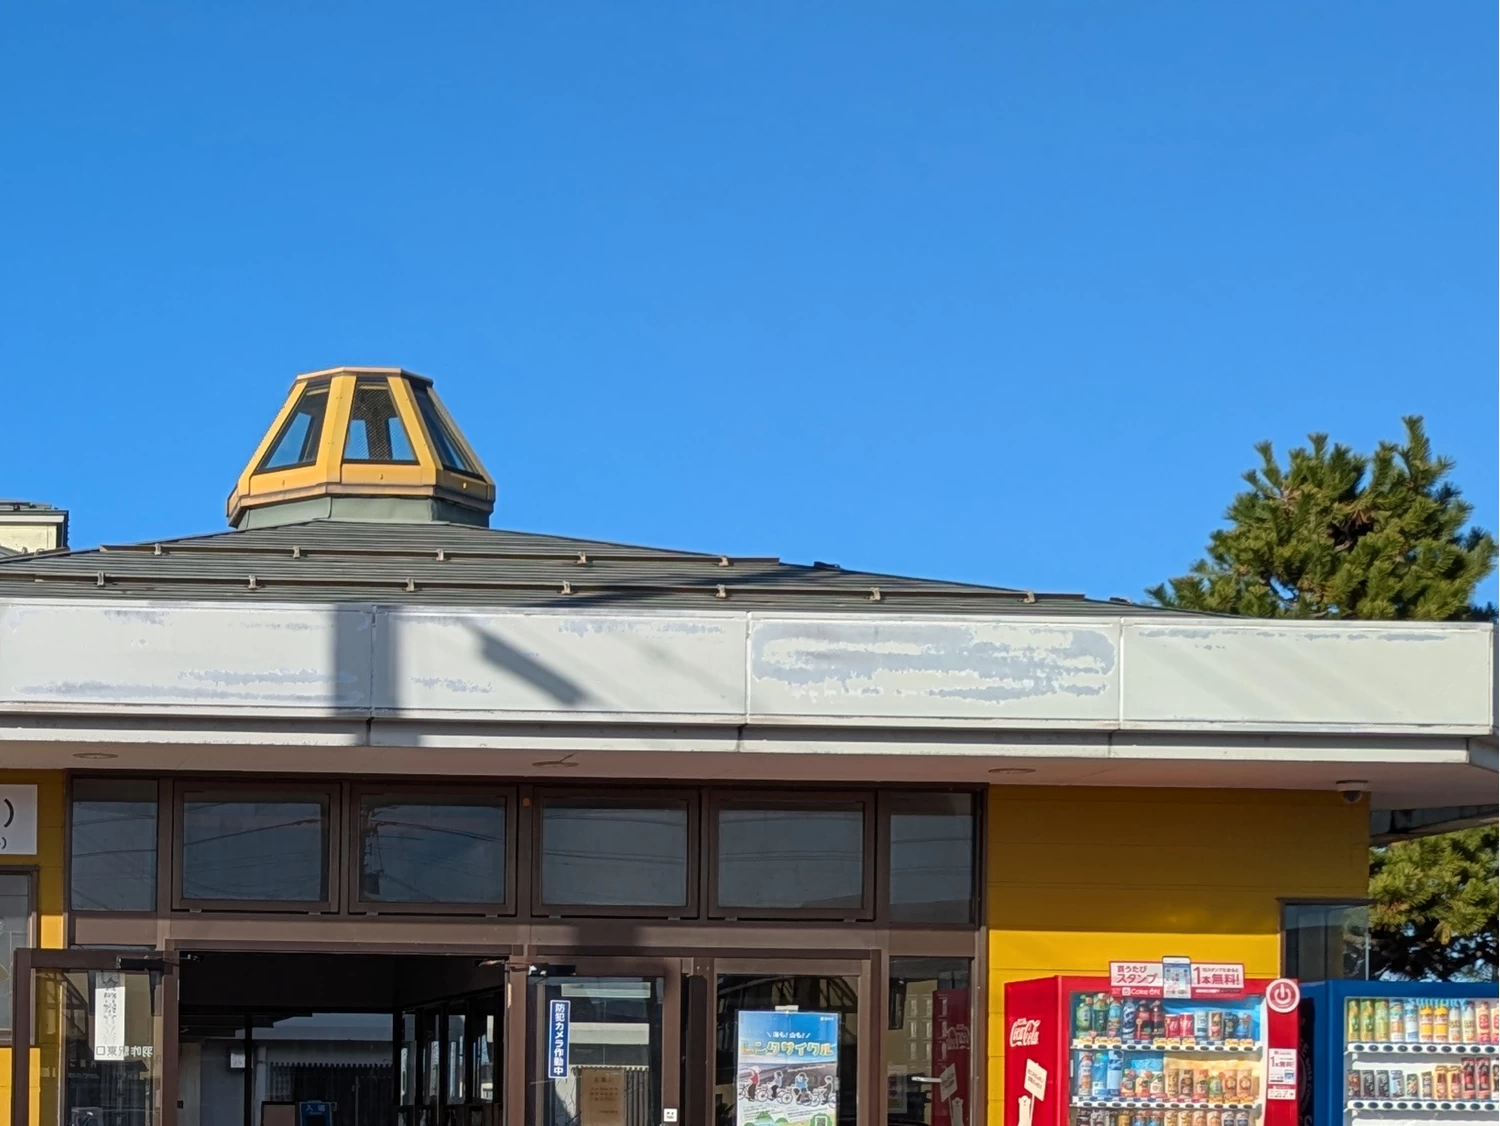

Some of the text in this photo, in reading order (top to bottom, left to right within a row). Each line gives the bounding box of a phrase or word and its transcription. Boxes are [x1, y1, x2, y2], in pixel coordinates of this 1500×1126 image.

[1116, 973, 1159, 985] スタンプ
[553, 1003, 566, 1076] 防犯カメラ作動中
[741, 1040, 834, 1057] レンタサイクル
